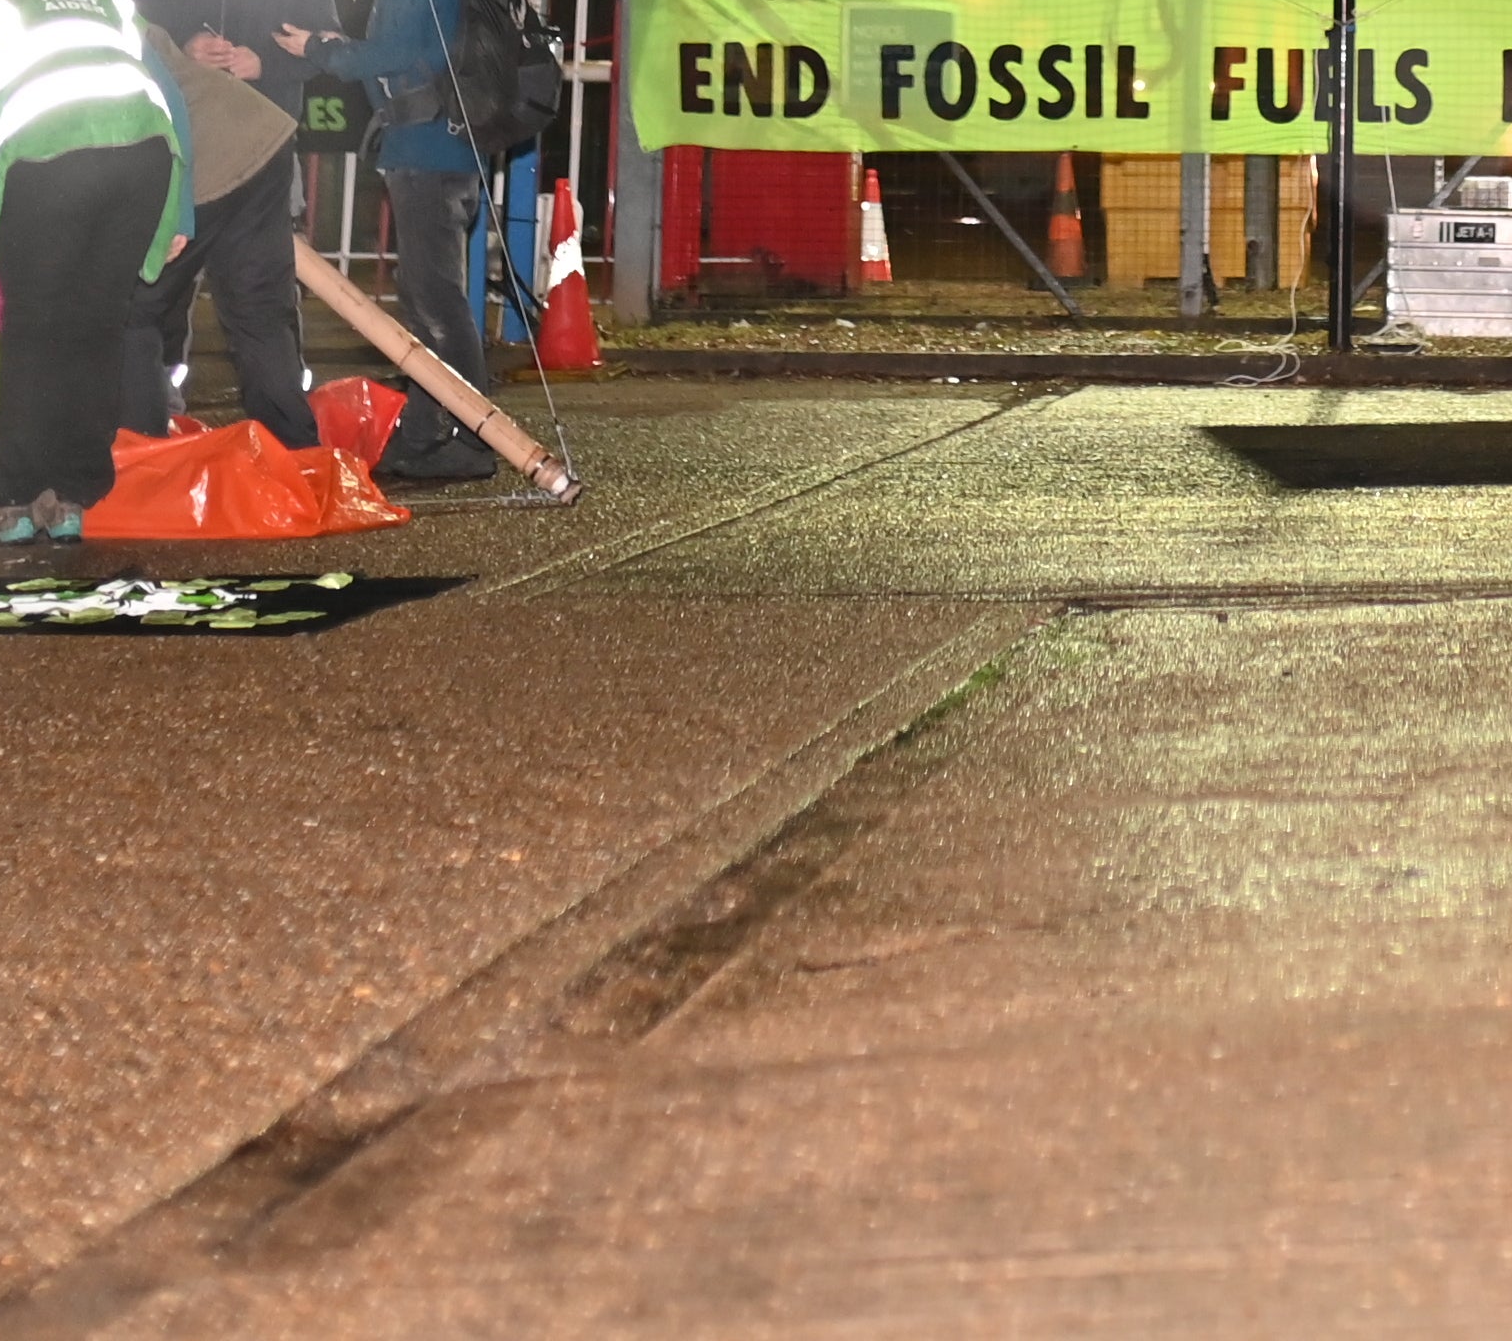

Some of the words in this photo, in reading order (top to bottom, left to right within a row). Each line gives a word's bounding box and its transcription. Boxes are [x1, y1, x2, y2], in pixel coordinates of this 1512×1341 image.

[679, 42, 831, 119] END
[880, 41, 1151, 121] FOSSIL
[1210, 47, 1433, 125] FUELS
[302, 97, 347, 132] ES
